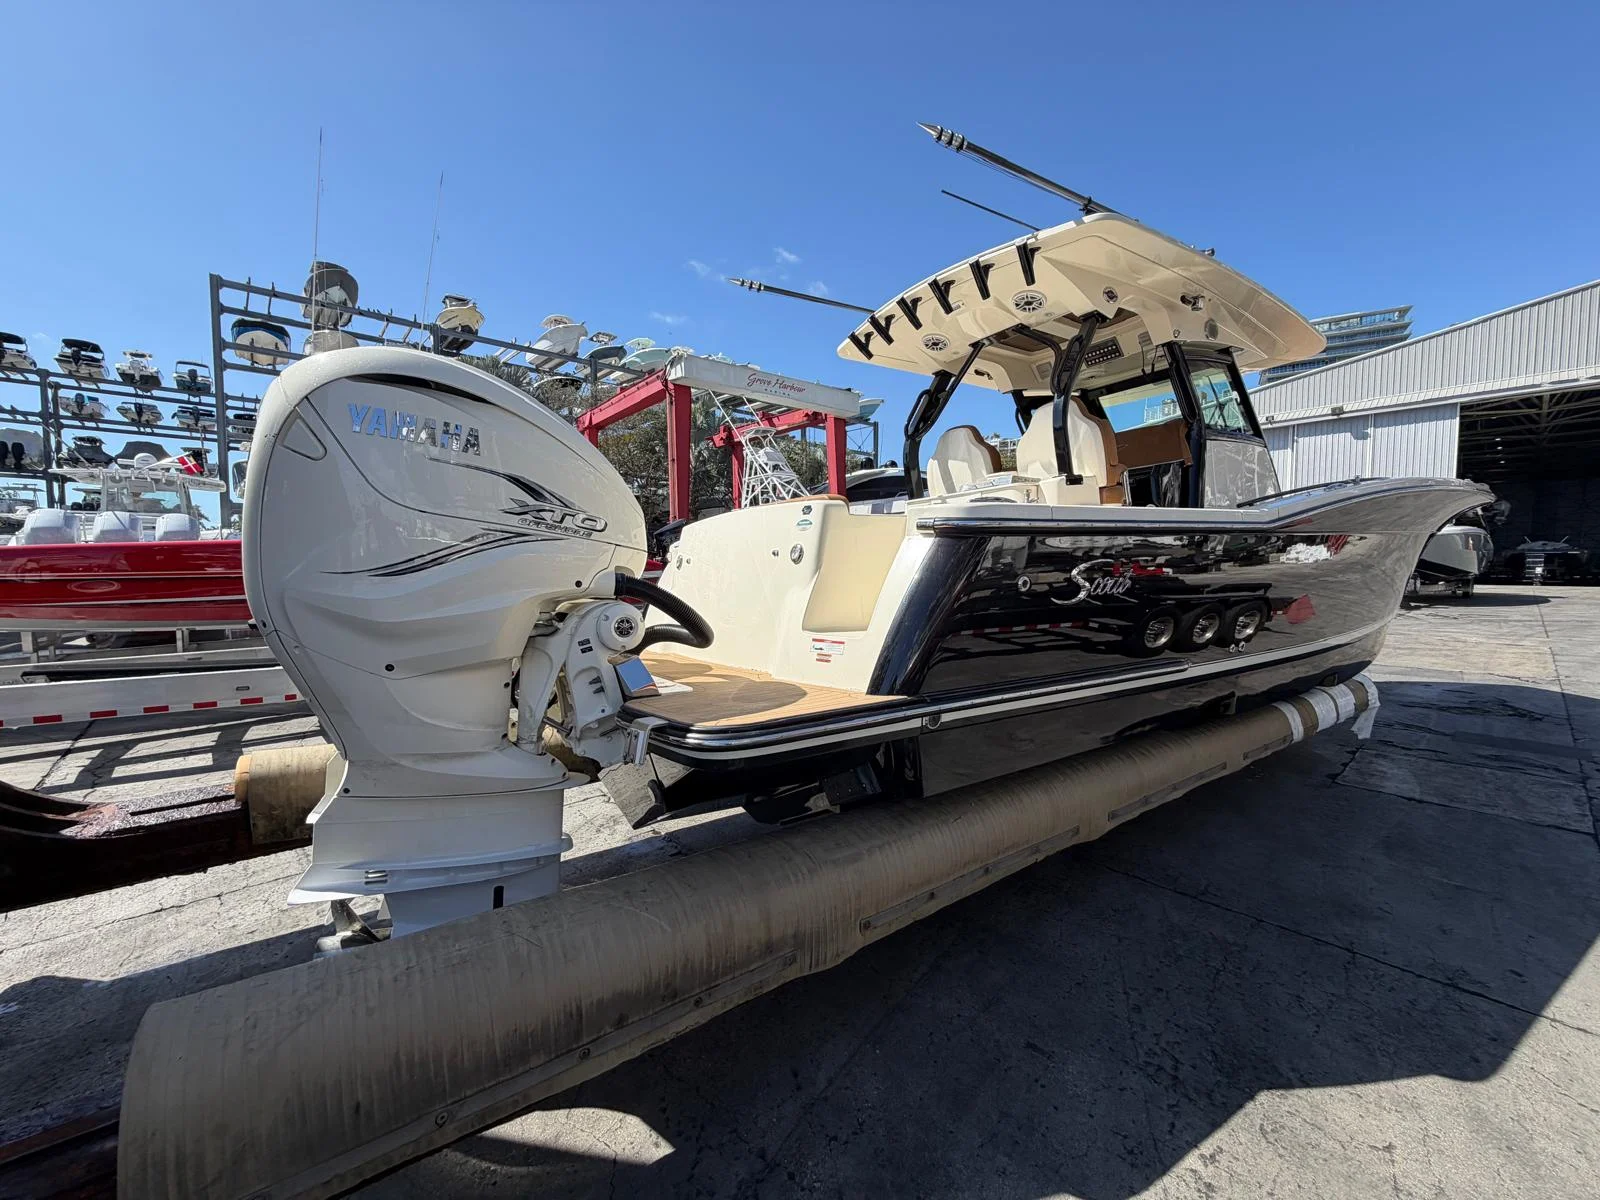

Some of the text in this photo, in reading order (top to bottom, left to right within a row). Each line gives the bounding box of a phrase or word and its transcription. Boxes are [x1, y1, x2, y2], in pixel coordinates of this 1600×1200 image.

[747, 373, 771, 387] Grove
[772, 378, 806, 393] Harbour
[347, 403, 481, 456] YAMAHA
[499, 497, 608, 532] XTO
[1050, 558, 1135, 605] Scout
